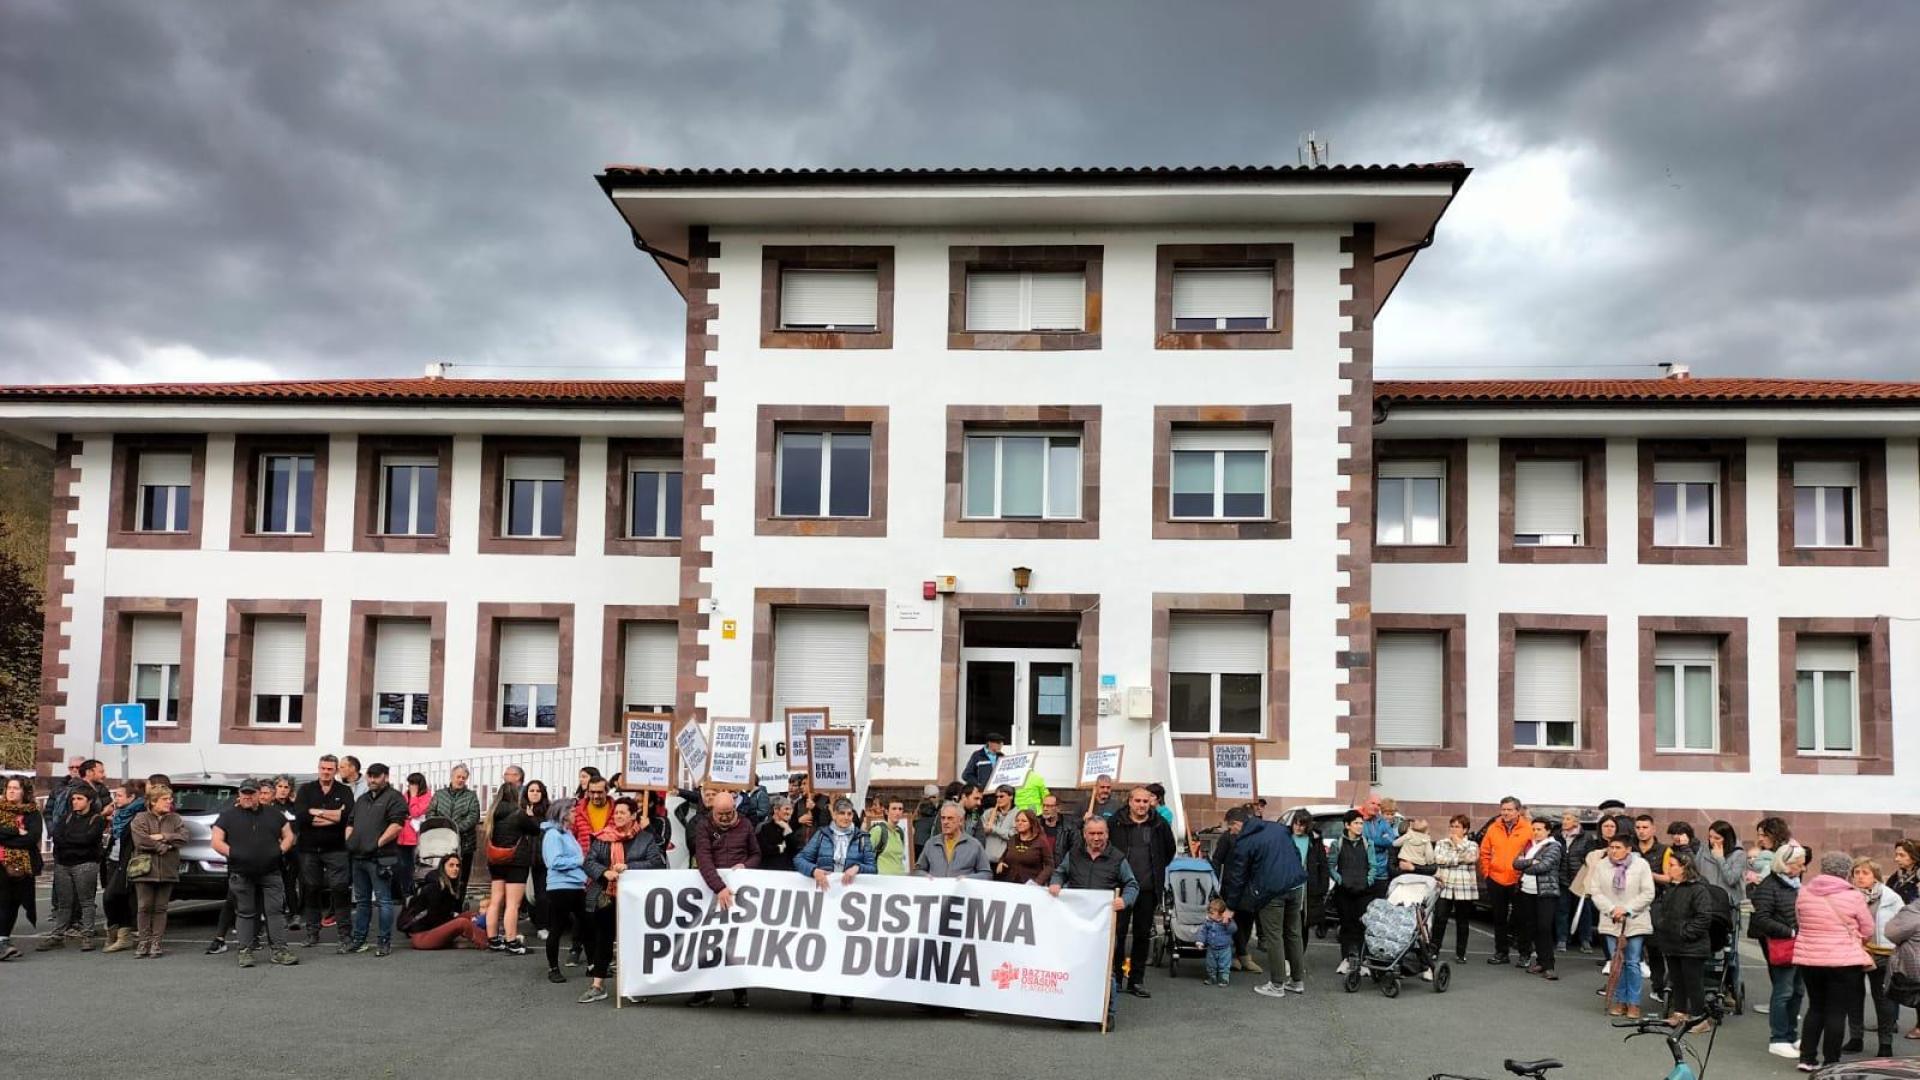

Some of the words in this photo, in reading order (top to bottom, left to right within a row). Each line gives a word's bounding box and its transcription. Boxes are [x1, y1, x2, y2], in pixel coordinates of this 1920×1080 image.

[630, 721, 664, 731] OSASUN
[717, 725, 746, 733] OSASUN
[630, 731, 668, 741] ZERBITZU
[630, 739, 665, 749] PUBLIKO
[815, 763, 836, 771] BETE
[1217, 760, 1249, 768] PUBLIKO
[815, 771, 848, 780] GRAIN!!
[644, 885, 824, 930] OSASUN
[837, 891, 1036, 945] SISTEMA
[643, 927, 827, 975] PUBLIKO
[840, 935, 981, 988] DUINA
[1022, 967, 1070, 981] BAZTANGO
[1021, 976, 1057, 988] OSASUN
